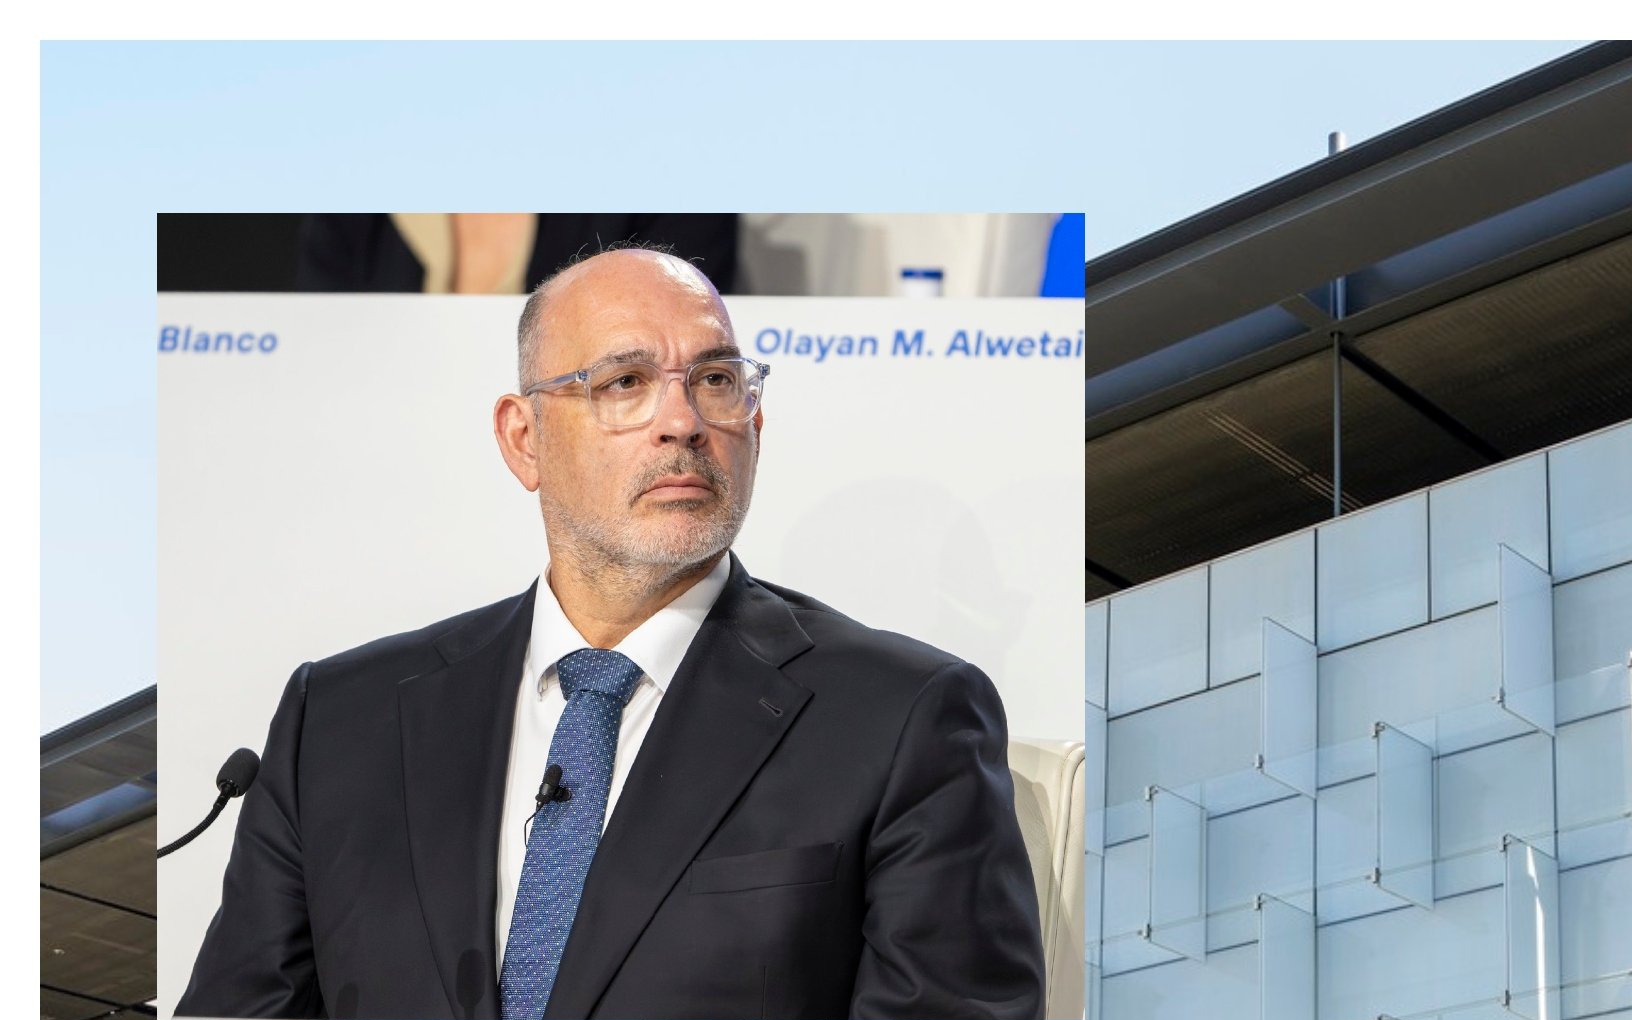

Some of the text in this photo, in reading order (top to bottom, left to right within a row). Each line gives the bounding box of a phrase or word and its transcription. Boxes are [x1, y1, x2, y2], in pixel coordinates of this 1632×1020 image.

[158, 325, 279, 353] Blanco
[755, 328, 1084, 362] Olayan M. Alwetai
